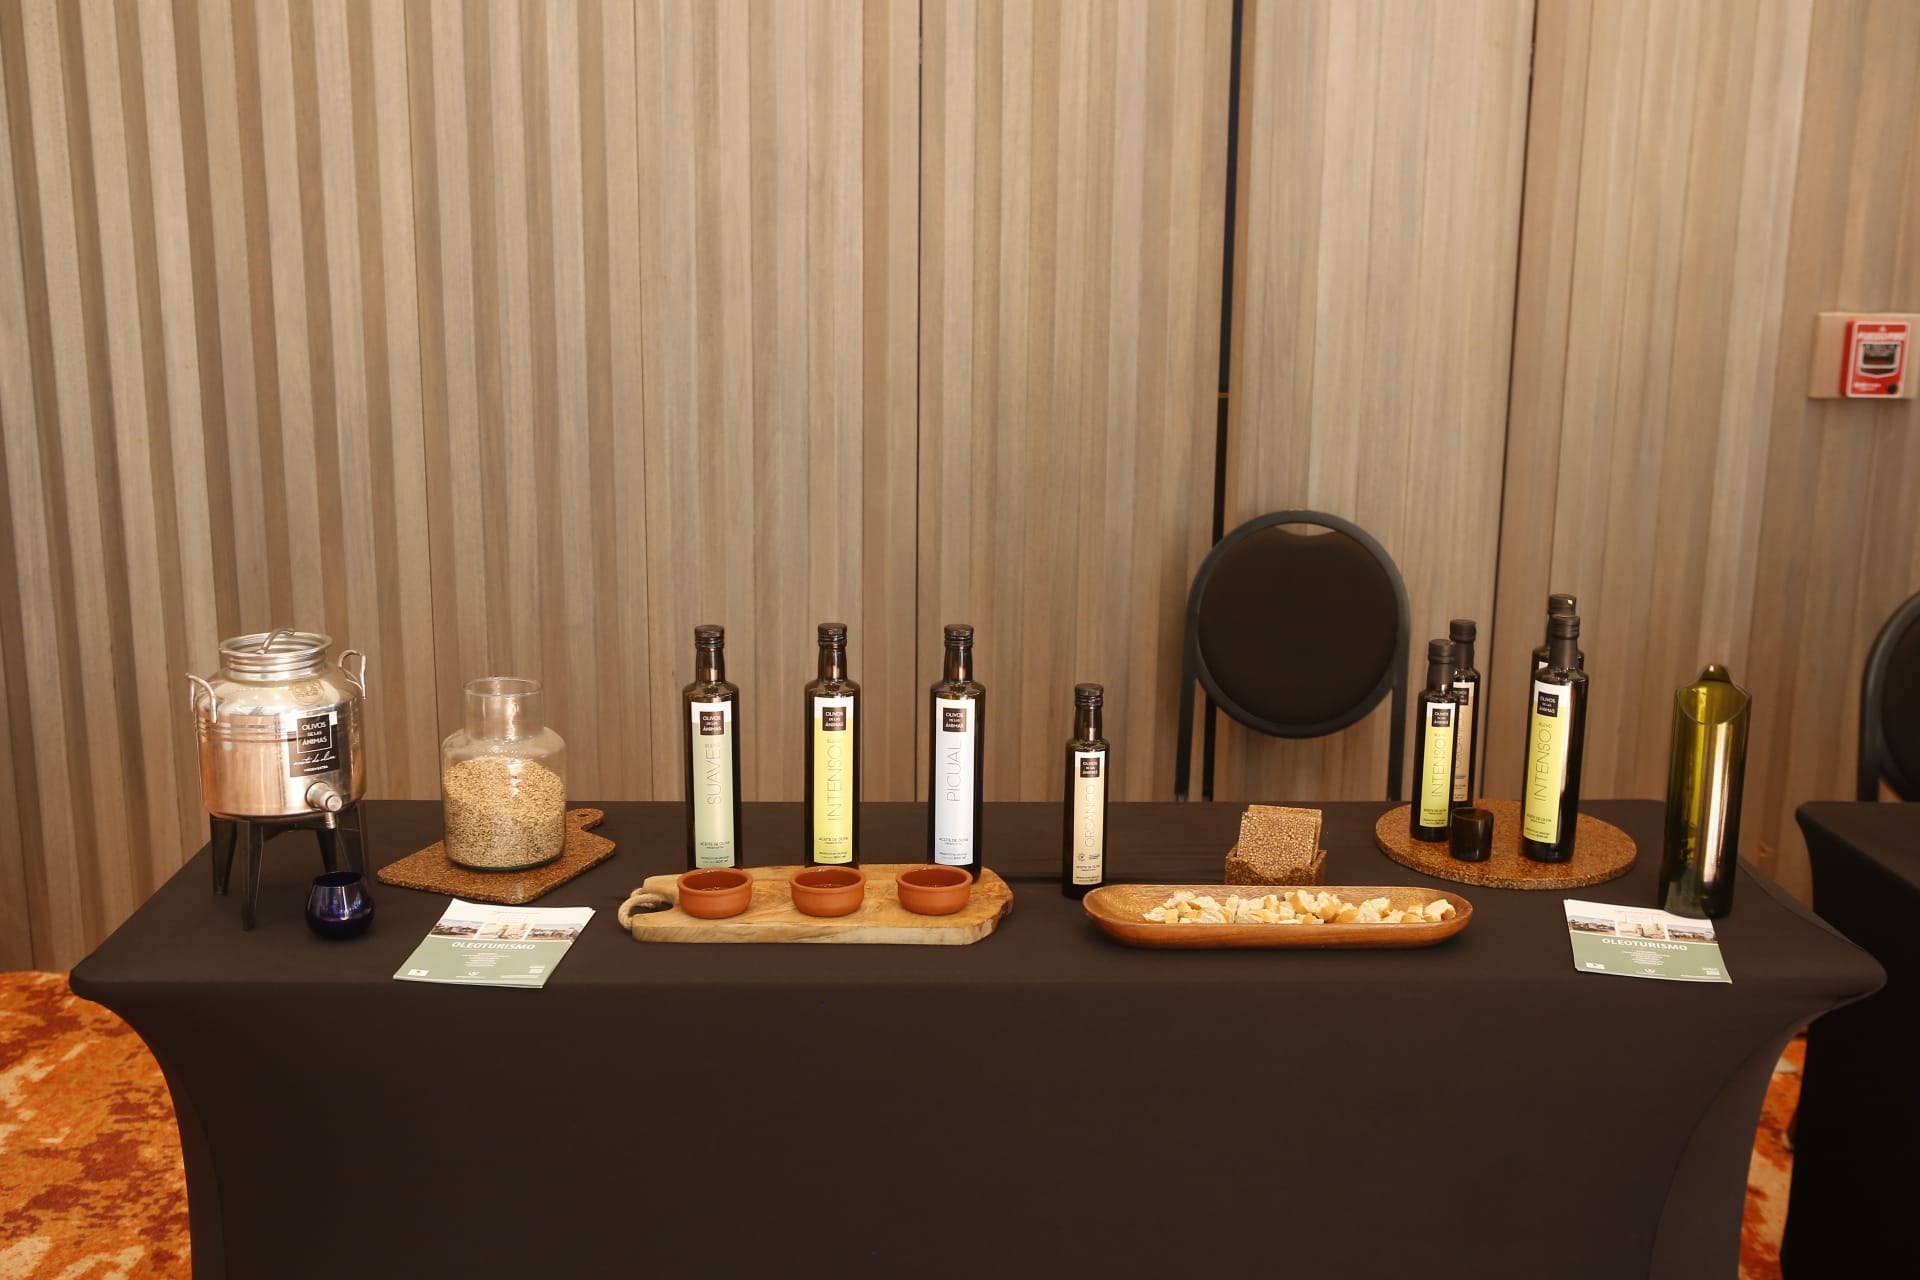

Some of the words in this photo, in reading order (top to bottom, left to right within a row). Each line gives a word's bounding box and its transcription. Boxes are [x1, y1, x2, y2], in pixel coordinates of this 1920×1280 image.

[1540, 696, 1556, 704] OLIVOS
[302, 722, 326, 730] OLIVOS
[302, 736, 328, 746] ÁNIMAS
[706, 750, 722, 804] SUAVE
[946, 739, 962, 802] PICUAL
[1432, 738, 1446, 797] INTENSO
[1534, 728, 1552, 802] INTENSO
[828, 745, 842, 820] INTENSO
[451, 942, 536, 950] OLEOTURISMO
[1602, 938, 1688, 951] OLEOTURISMO
